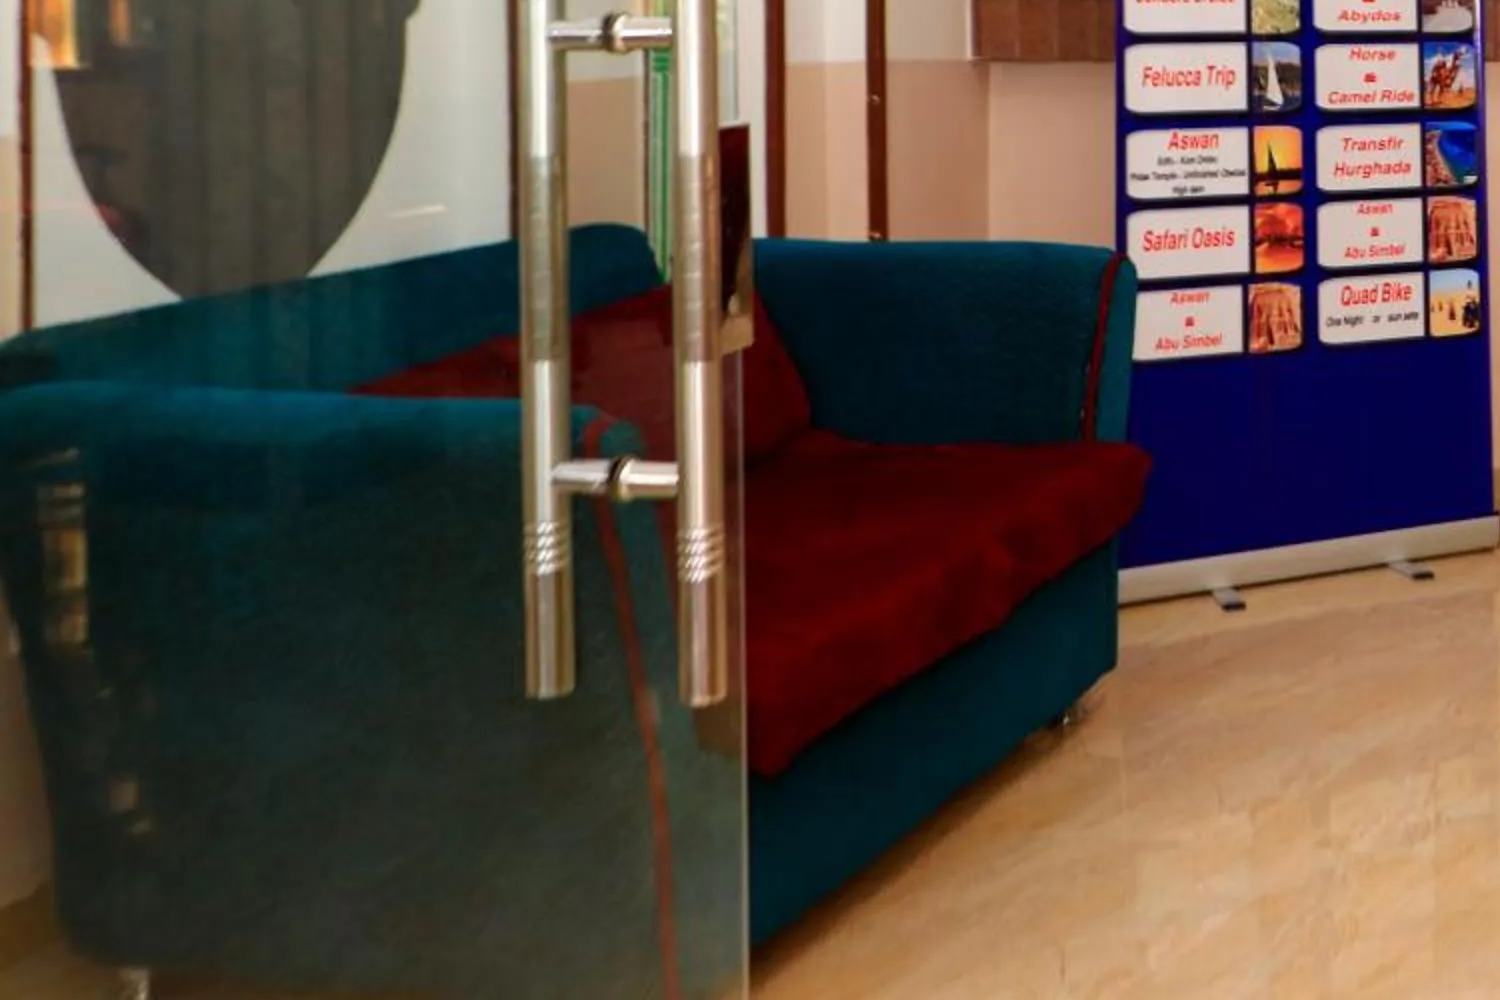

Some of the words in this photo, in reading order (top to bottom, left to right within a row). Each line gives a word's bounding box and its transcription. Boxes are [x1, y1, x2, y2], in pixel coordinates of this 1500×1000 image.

[1338, 10, 1402, 23] Abydos
[1348, 48, 1396, 61] Horse
[1142, 66, 1202, 87] Felucca
[1207, 66, 1236, 89] Trip
[1327, 90, 1377, 104] Camel
[1380, 89, 1415, 102] Ride
[1167, 132, 1219, 150] Aswan
[1341, 136, 1405, 151] Transfir
[1334, 161, 1412, 178] Hurghada
[1357, 203, 1394, 214] Aswan
[1143, 229, 1190, 251] Safari
[1192, 227, 1235, 249] Oasis
[1341, 285, 1378, 306] Quad
[1382, 282, 1412, 303] Bike
[1156, 337, 1179, 350] Abu
[1183, 332, 1222, 348] Simbel
